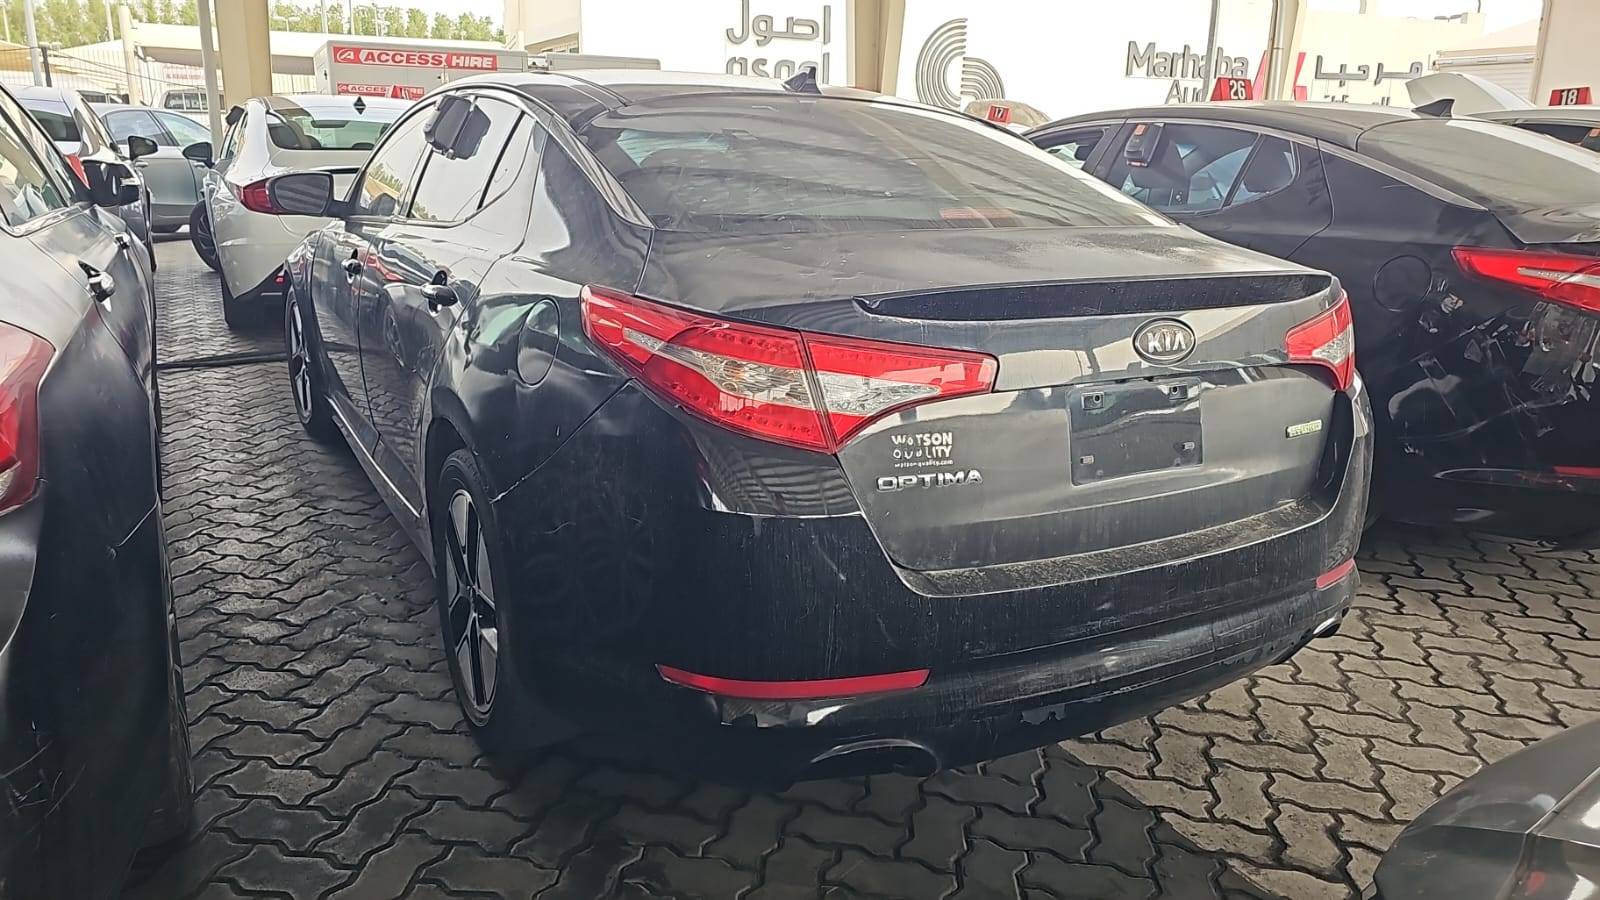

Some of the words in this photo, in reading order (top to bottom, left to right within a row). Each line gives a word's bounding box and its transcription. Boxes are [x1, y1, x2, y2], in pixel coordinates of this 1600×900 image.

[363, 51, 444, 66] ACCESS
[451, 55, 494, 69] HIRE
[1229, 80, 1247, 100] 26
[1560, 89, 1578, 105] 18
[1146, 329, 1186, 353] KIA
[877, 469, 982, 492] OPTIMA
